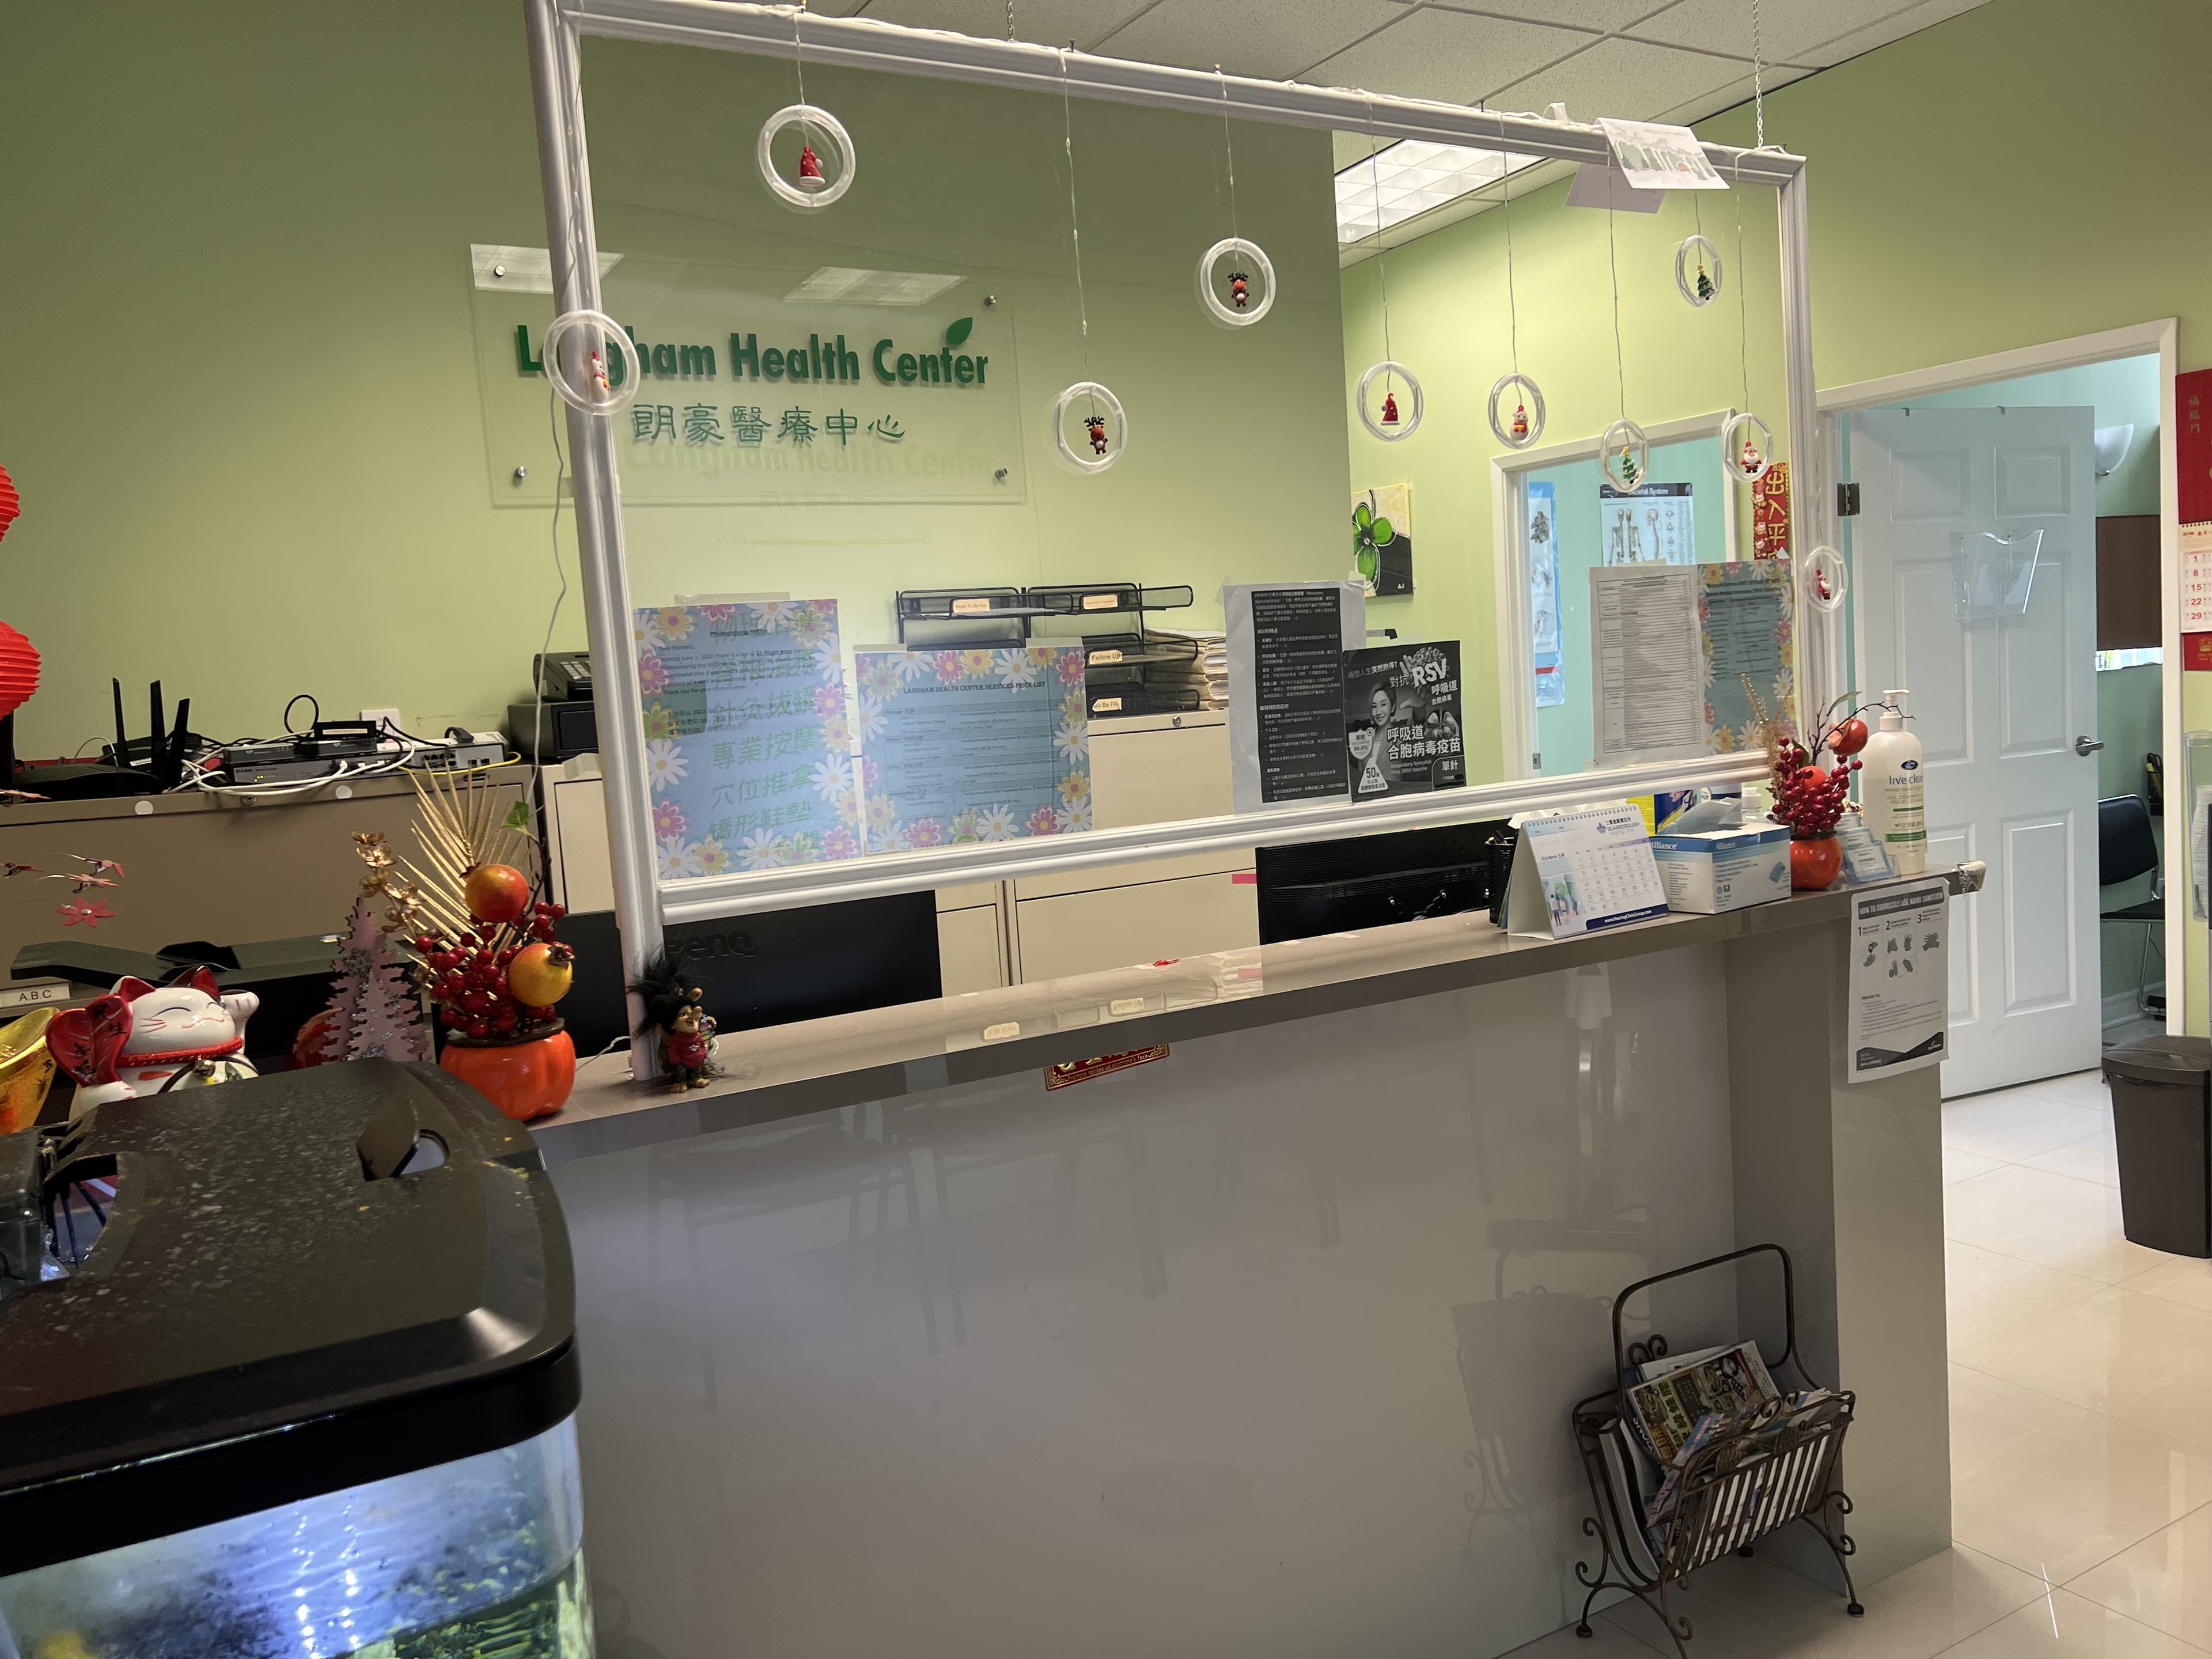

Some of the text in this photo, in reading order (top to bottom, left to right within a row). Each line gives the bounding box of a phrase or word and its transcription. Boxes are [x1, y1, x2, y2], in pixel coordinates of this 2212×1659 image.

[517, 324, 990, 386] Lgham Health Center
[631, 402, 906, 446] 朗豪醫療中心
[1649, 488, 1669, 496] System
[2191, 583, 2202, 591] 15
[2190, 597, 2202, 605] 22
[2191, 612, 2202, 620] 29
[1412, 658, 1447, 687] RSV
[1389, 675, 1409, 688] 對抗
[1431, 680, 1458, 695] 呼吸道
[1387, 724, 1425, 743] 呼吸道
[1388, 737, 1461, 760] 合胞病毒疫苗
[1889, 774, 1907, 785] live
[1607, 822, 1639, 832] SCARBOROUGH
[1859, 907, 1869, 915] HOW
[1870, 905, 1877, 913] TO
[1877, 902, 1901, 911] CORRECTLY
[1910, 896, 1922, 905] HAND
[1922, 892, 1943, 903] SANITIZER
[1916, 913, 1922, 924] 3
[1885, 920, 1891, 931] 2
[1858, 926, 1862, 937] 1
[19, 989, 51, 1001] A.B.C
